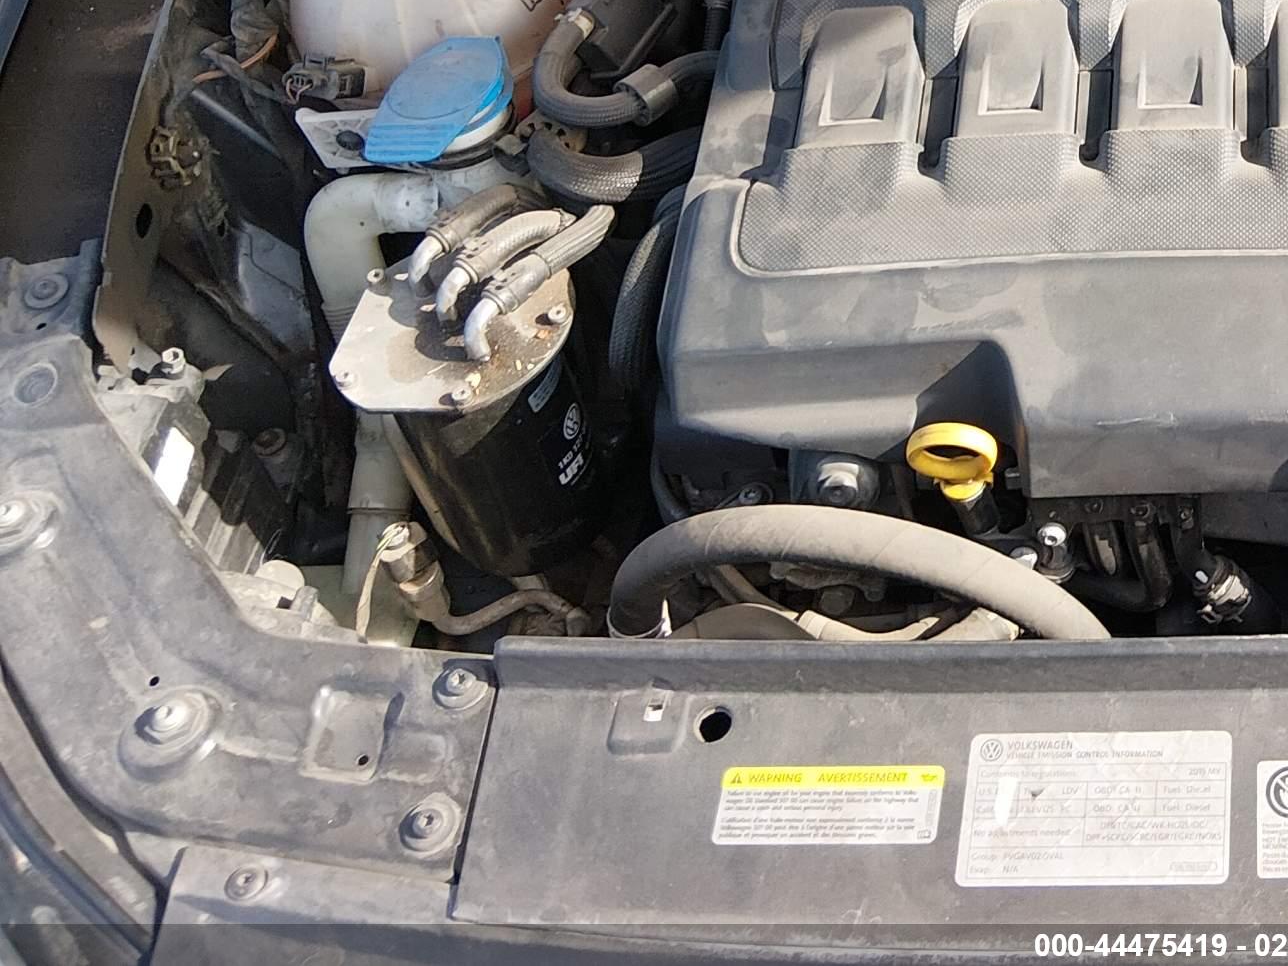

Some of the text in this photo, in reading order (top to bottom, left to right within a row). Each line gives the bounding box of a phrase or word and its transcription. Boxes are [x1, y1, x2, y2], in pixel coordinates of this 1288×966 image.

[1007, 740, 1073, 750] VOLKSWAGEN
[1111, 750, 1163, 758] INFORMATION
[748, 772, 908, 783] WARNING AVERTISSEMENT
